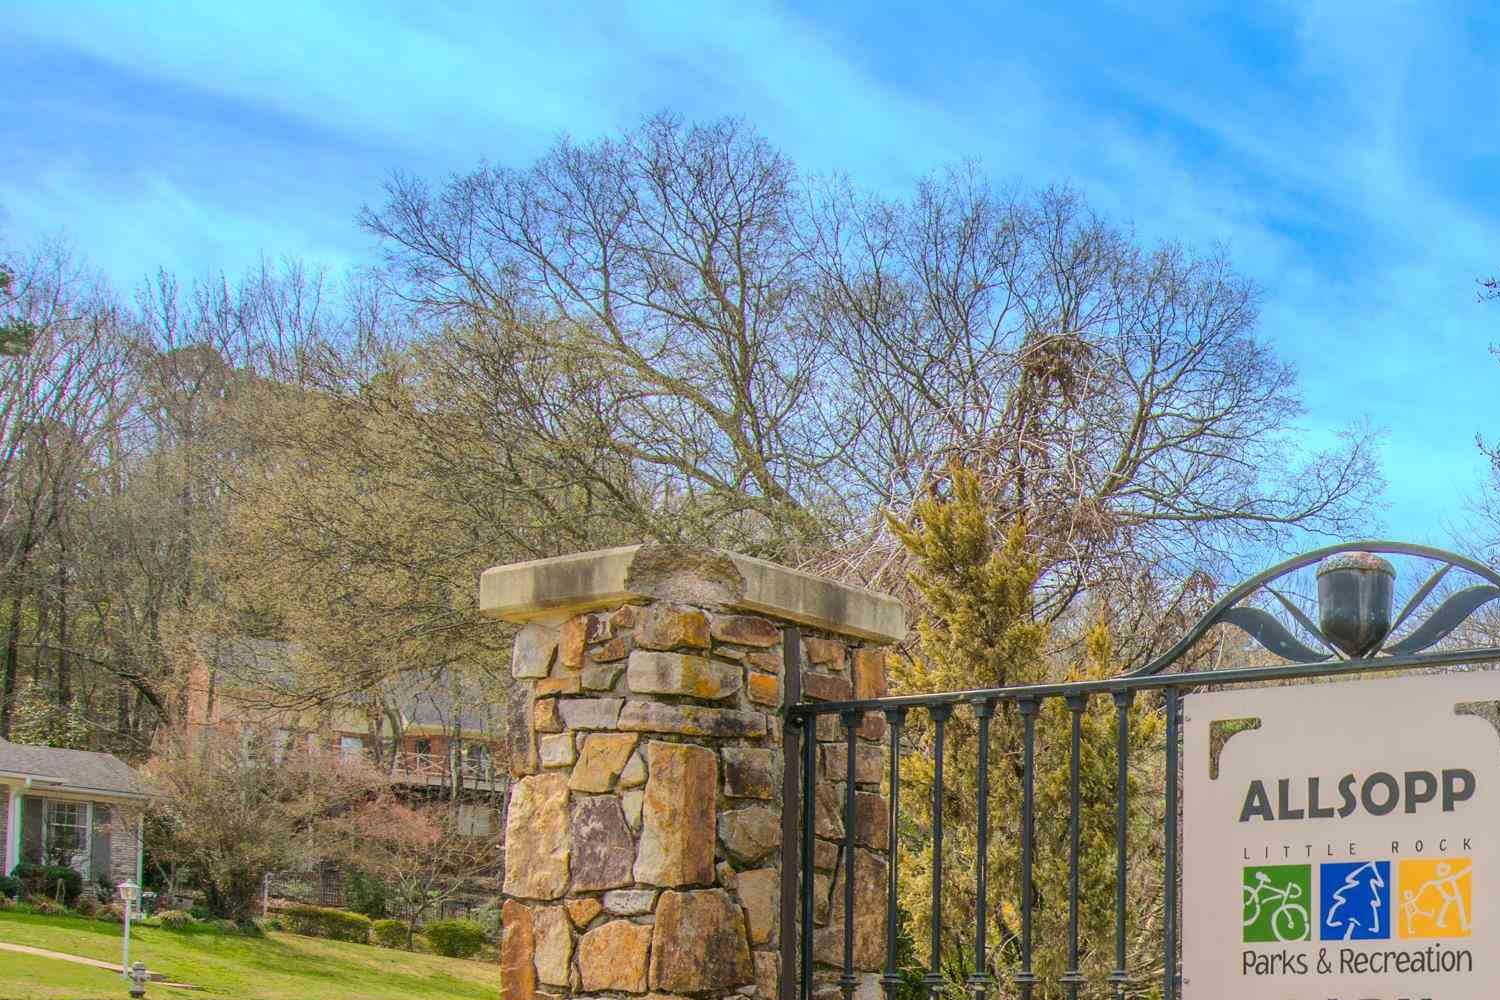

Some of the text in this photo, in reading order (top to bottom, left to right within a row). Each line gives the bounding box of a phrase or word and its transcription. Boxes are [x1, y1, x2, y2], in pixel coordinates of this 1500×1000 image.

[1239, 769, 1476, 822] ALLSOPP
[1243, 838, 1473, 860] LITTLE ROCK
[1242, 943, 1473, 975] Parks & Recreation
